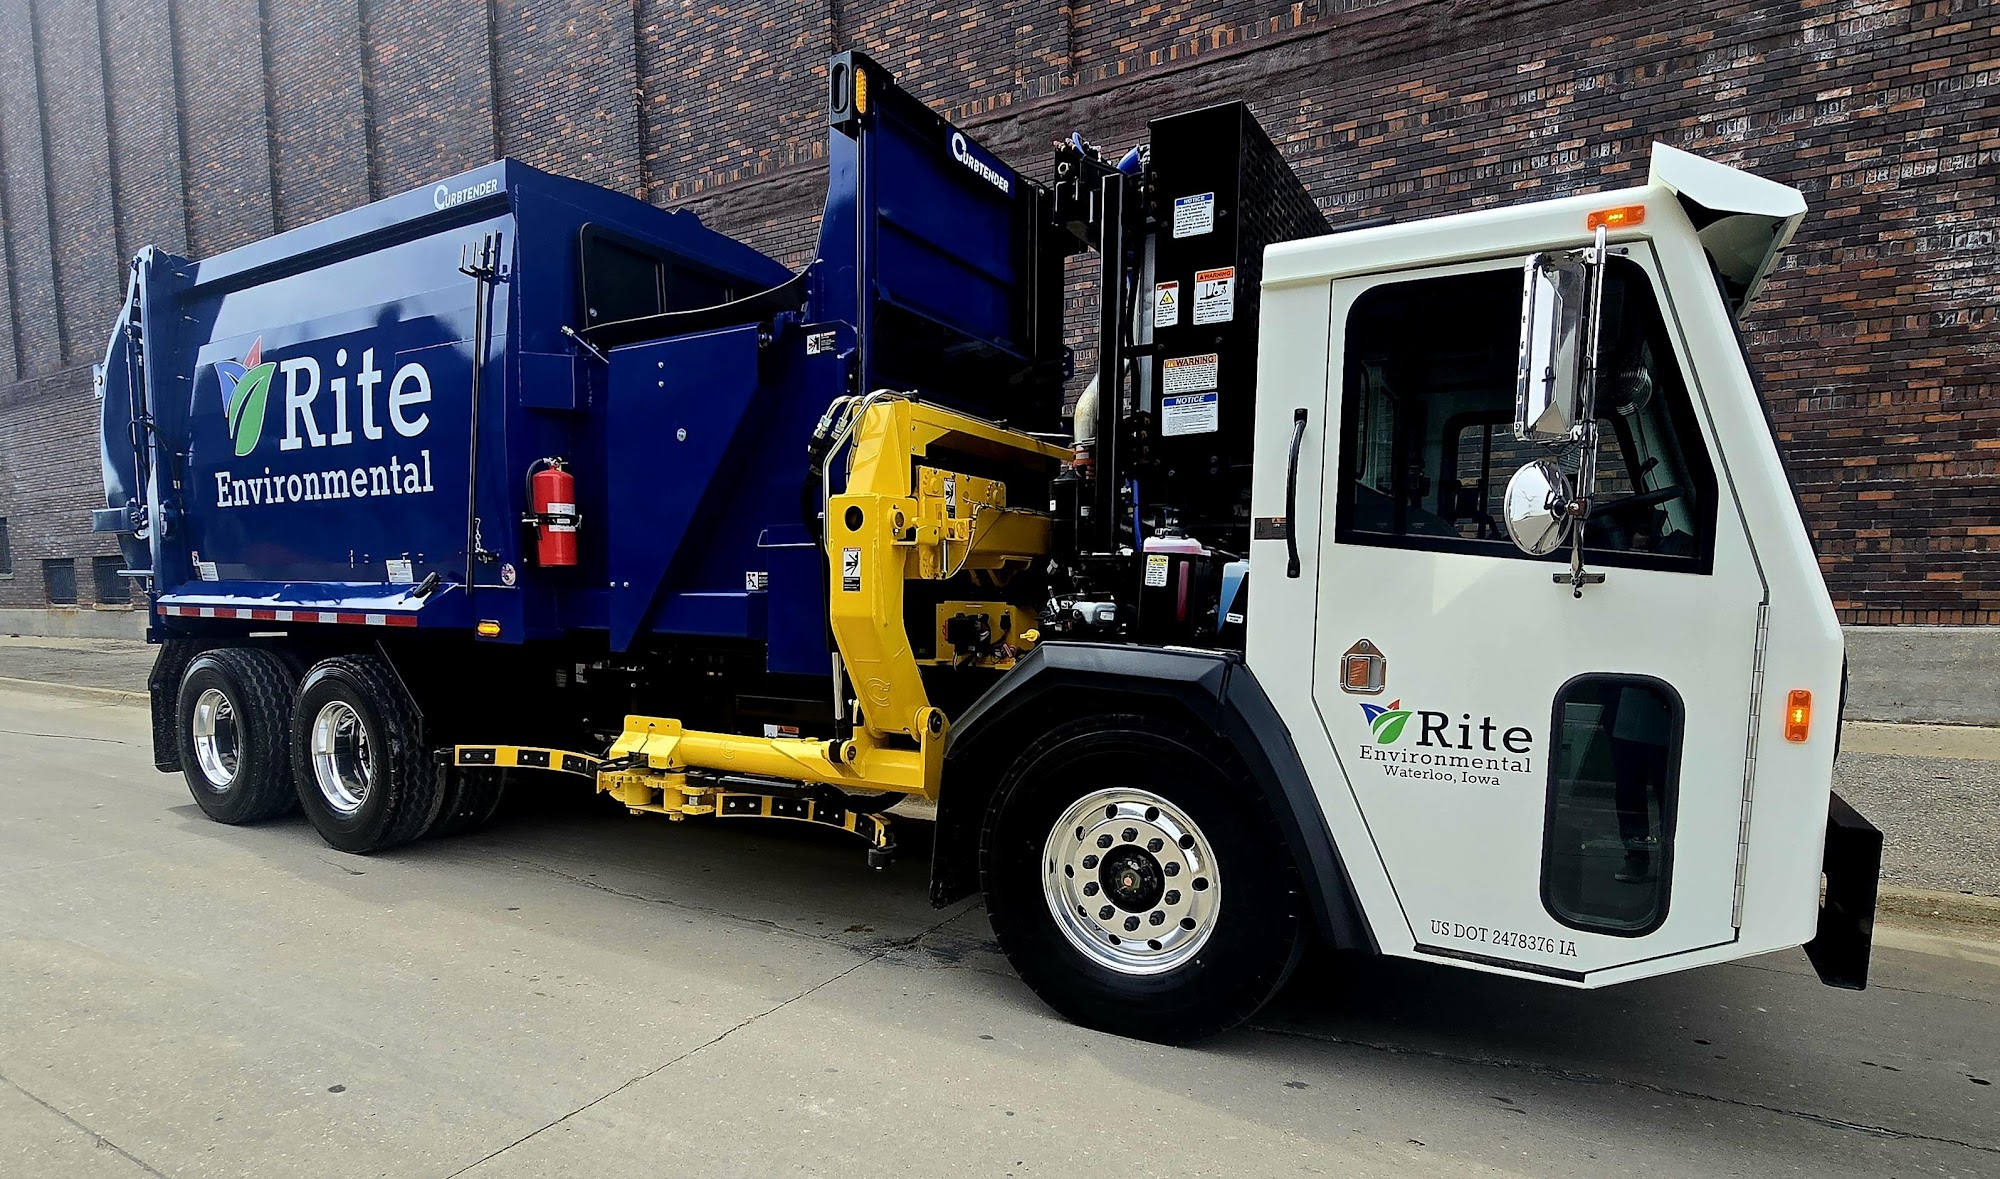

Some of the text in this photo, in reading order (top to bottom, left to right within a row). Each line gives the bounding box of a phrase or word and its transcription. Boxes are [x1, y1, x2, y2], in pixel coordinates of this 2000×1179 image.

[951, 132, 1009, 193] CURBTENDER
[433, 178, 498, 210] CURBTENDER
[1183, 196, 1206, 204] NOTICE
[1203, 271, 1231, 279] WARNING
[1175, 355, 1214, 367] WARNING
[280, 347, 432, 451] Rite
[1175, 395, 1206, 405] NOTICE
[214, 449, 434, 508] Environmental
[1415, 710, 1533, 754] Rite
[1359, 745, 1532, 773] Environmental
[1383, 764, 1500, 786] Waterloo, Iowa
[1430, 919, 1578, 957] US DOT 2478376 IA
